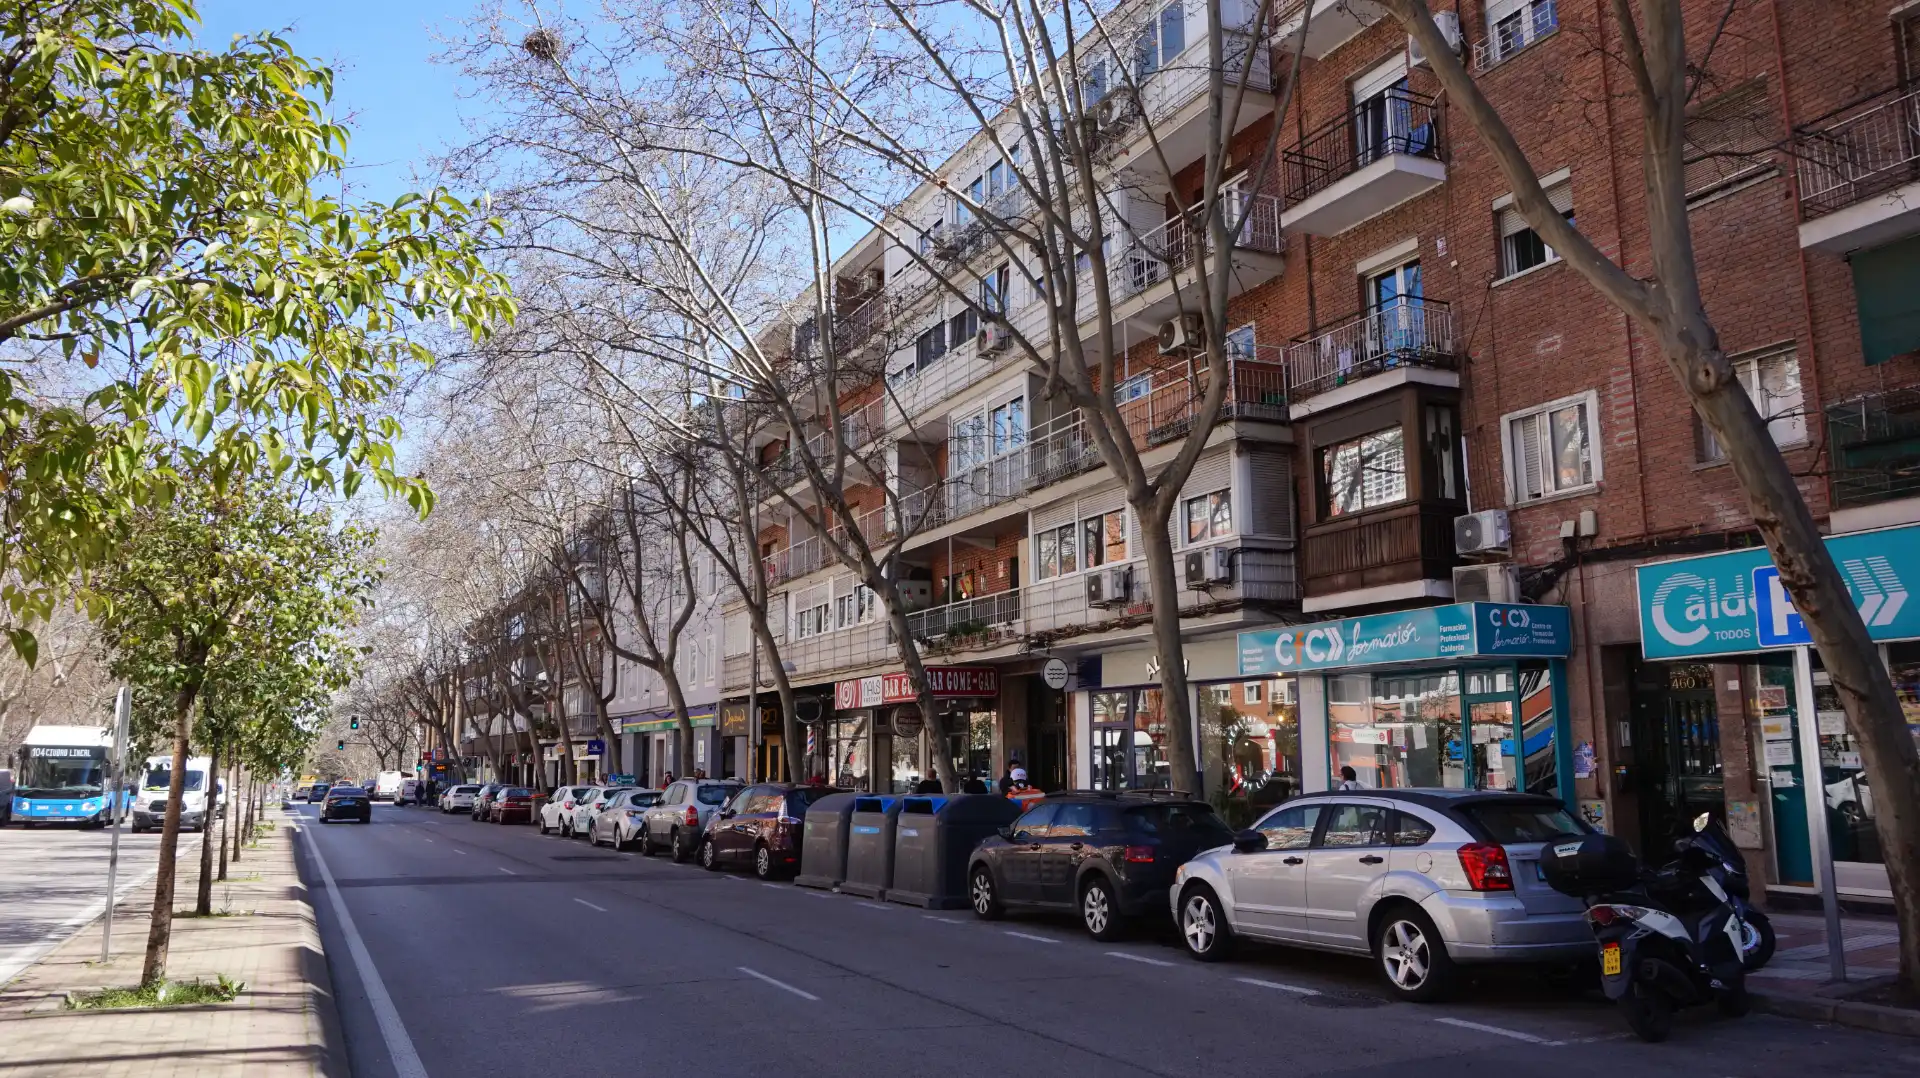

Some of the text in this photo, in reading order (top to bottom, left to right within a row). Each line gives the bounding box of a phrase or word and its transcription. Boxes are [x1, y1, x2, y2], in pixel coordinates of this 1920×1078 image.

[1714, 628, 1751, 641] TODOS
[884, 678, 899, 697] BAR
[926, 671, 944, 691] BAR
[1671, 676, 1696, 689] 460
[32, 747, 45, 757] 104
